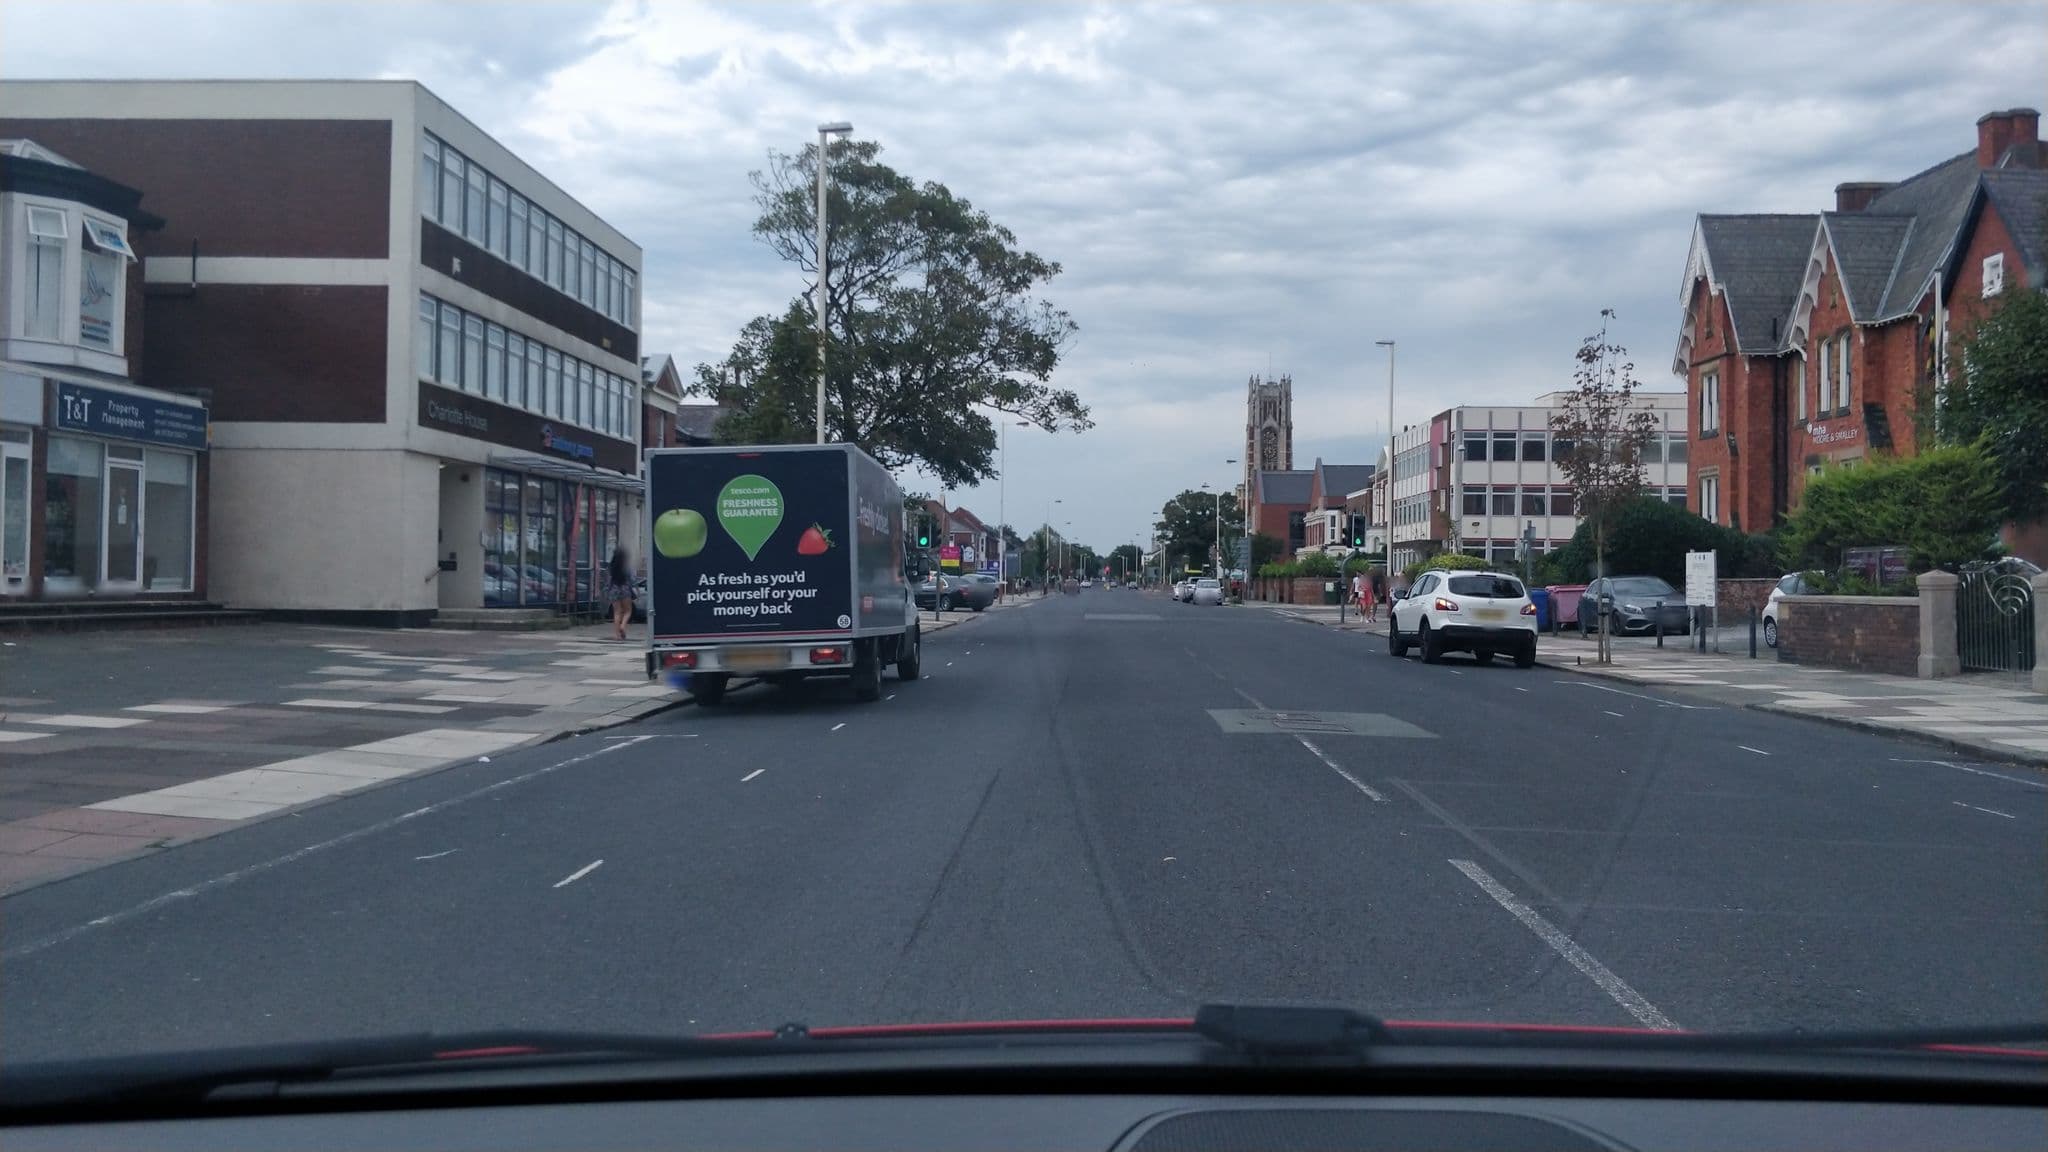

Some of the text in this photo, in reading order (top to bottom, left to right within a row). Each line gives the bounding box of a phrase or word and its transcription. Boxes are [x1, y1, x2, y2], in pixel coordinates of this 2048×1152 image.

[64, 395, 91, 422] T&T
[108, 400, 139, 416] Property
[102, 412, 145, 429] Management
[463, 411, 488, 432] House
[723, 498, 778, 508] FRESHNESS
[723, 508, 778, 517] GUARANTEE
[698, 571, 805, 585] As fresh as you'd
[688, 588, 817, 603] pick yourself or your
[714, 602, 792, 617] money back
